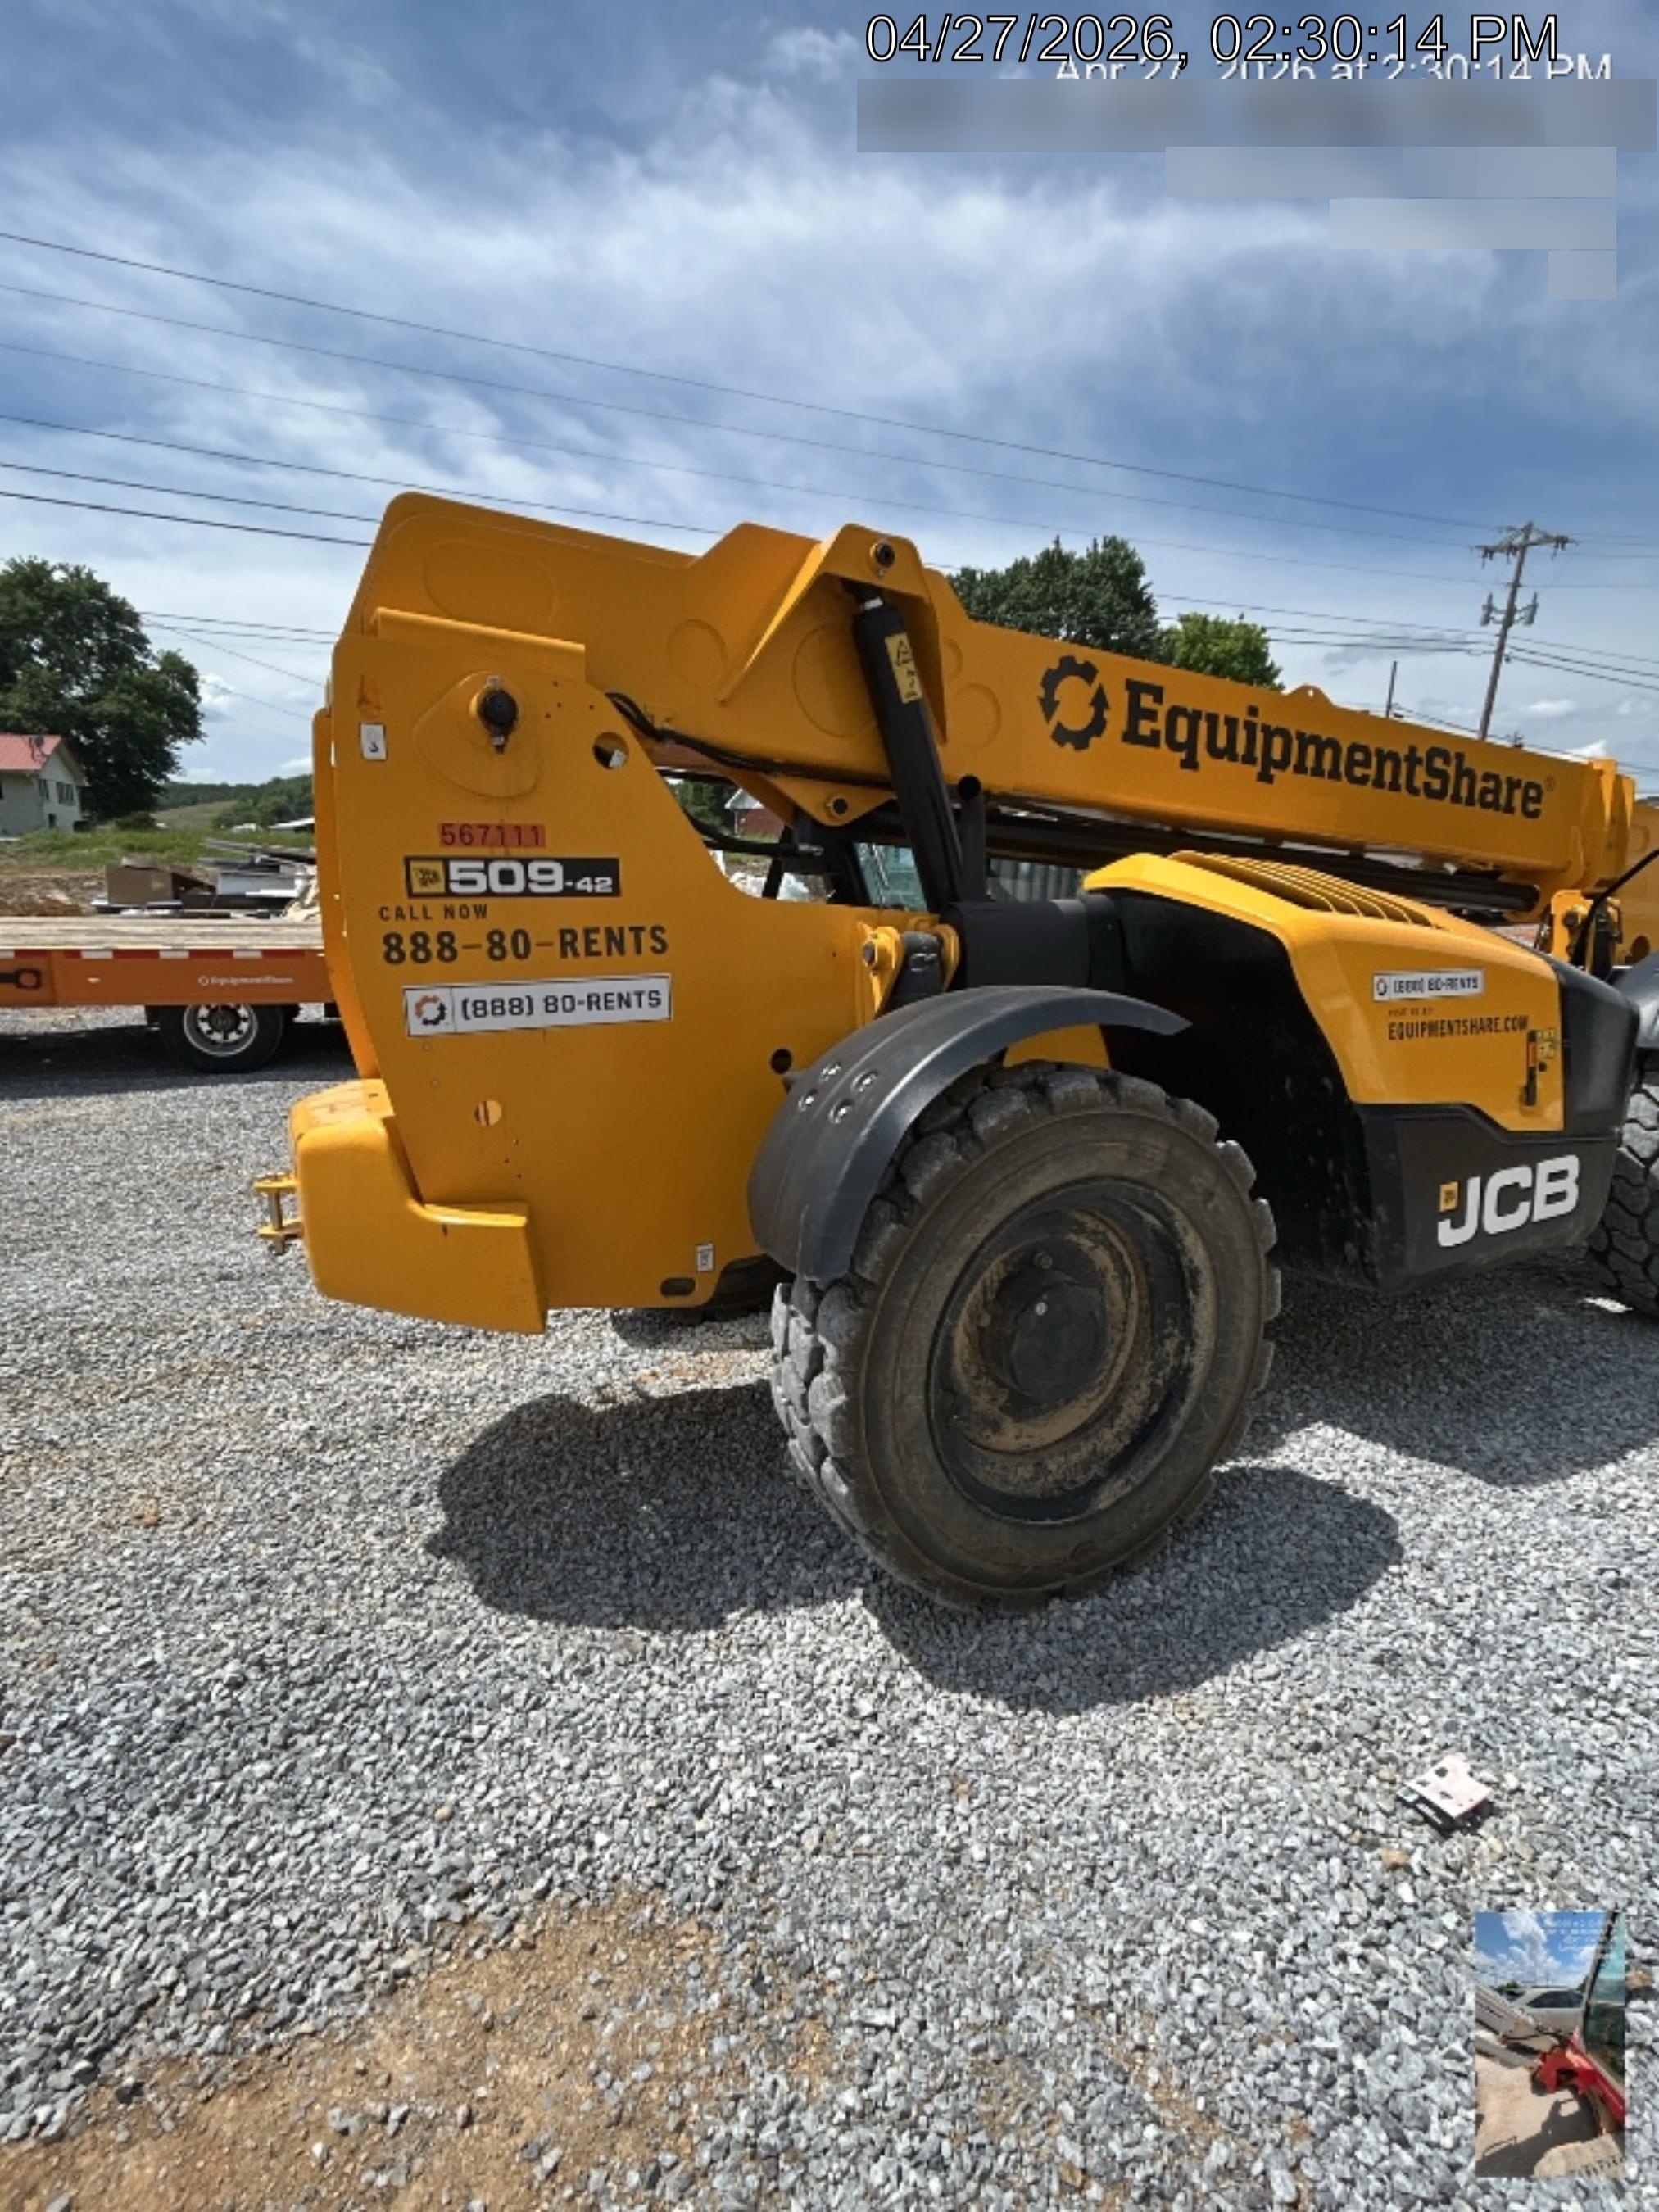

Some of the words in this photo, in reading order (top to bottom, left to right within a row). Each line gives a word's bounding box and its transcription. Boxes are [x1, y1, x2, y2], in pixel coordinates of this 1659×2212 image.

[440, 823, 542, 847] 567111
[448, 860, 614, 894] 509-42
[379, 906, 433, 922] CALL
[444, 904, 488, 920] NOW
[382, 924, 669, 965] 888-80-RENTS
[461, 995, 534, 1020] (888)
[543, 990, 662, 1013] 80-RENTS
[1388, 1015, 1530, 1040] EQUIPMENTSHARE.COM
[1437, 1154, 1580, 1248] JCB
